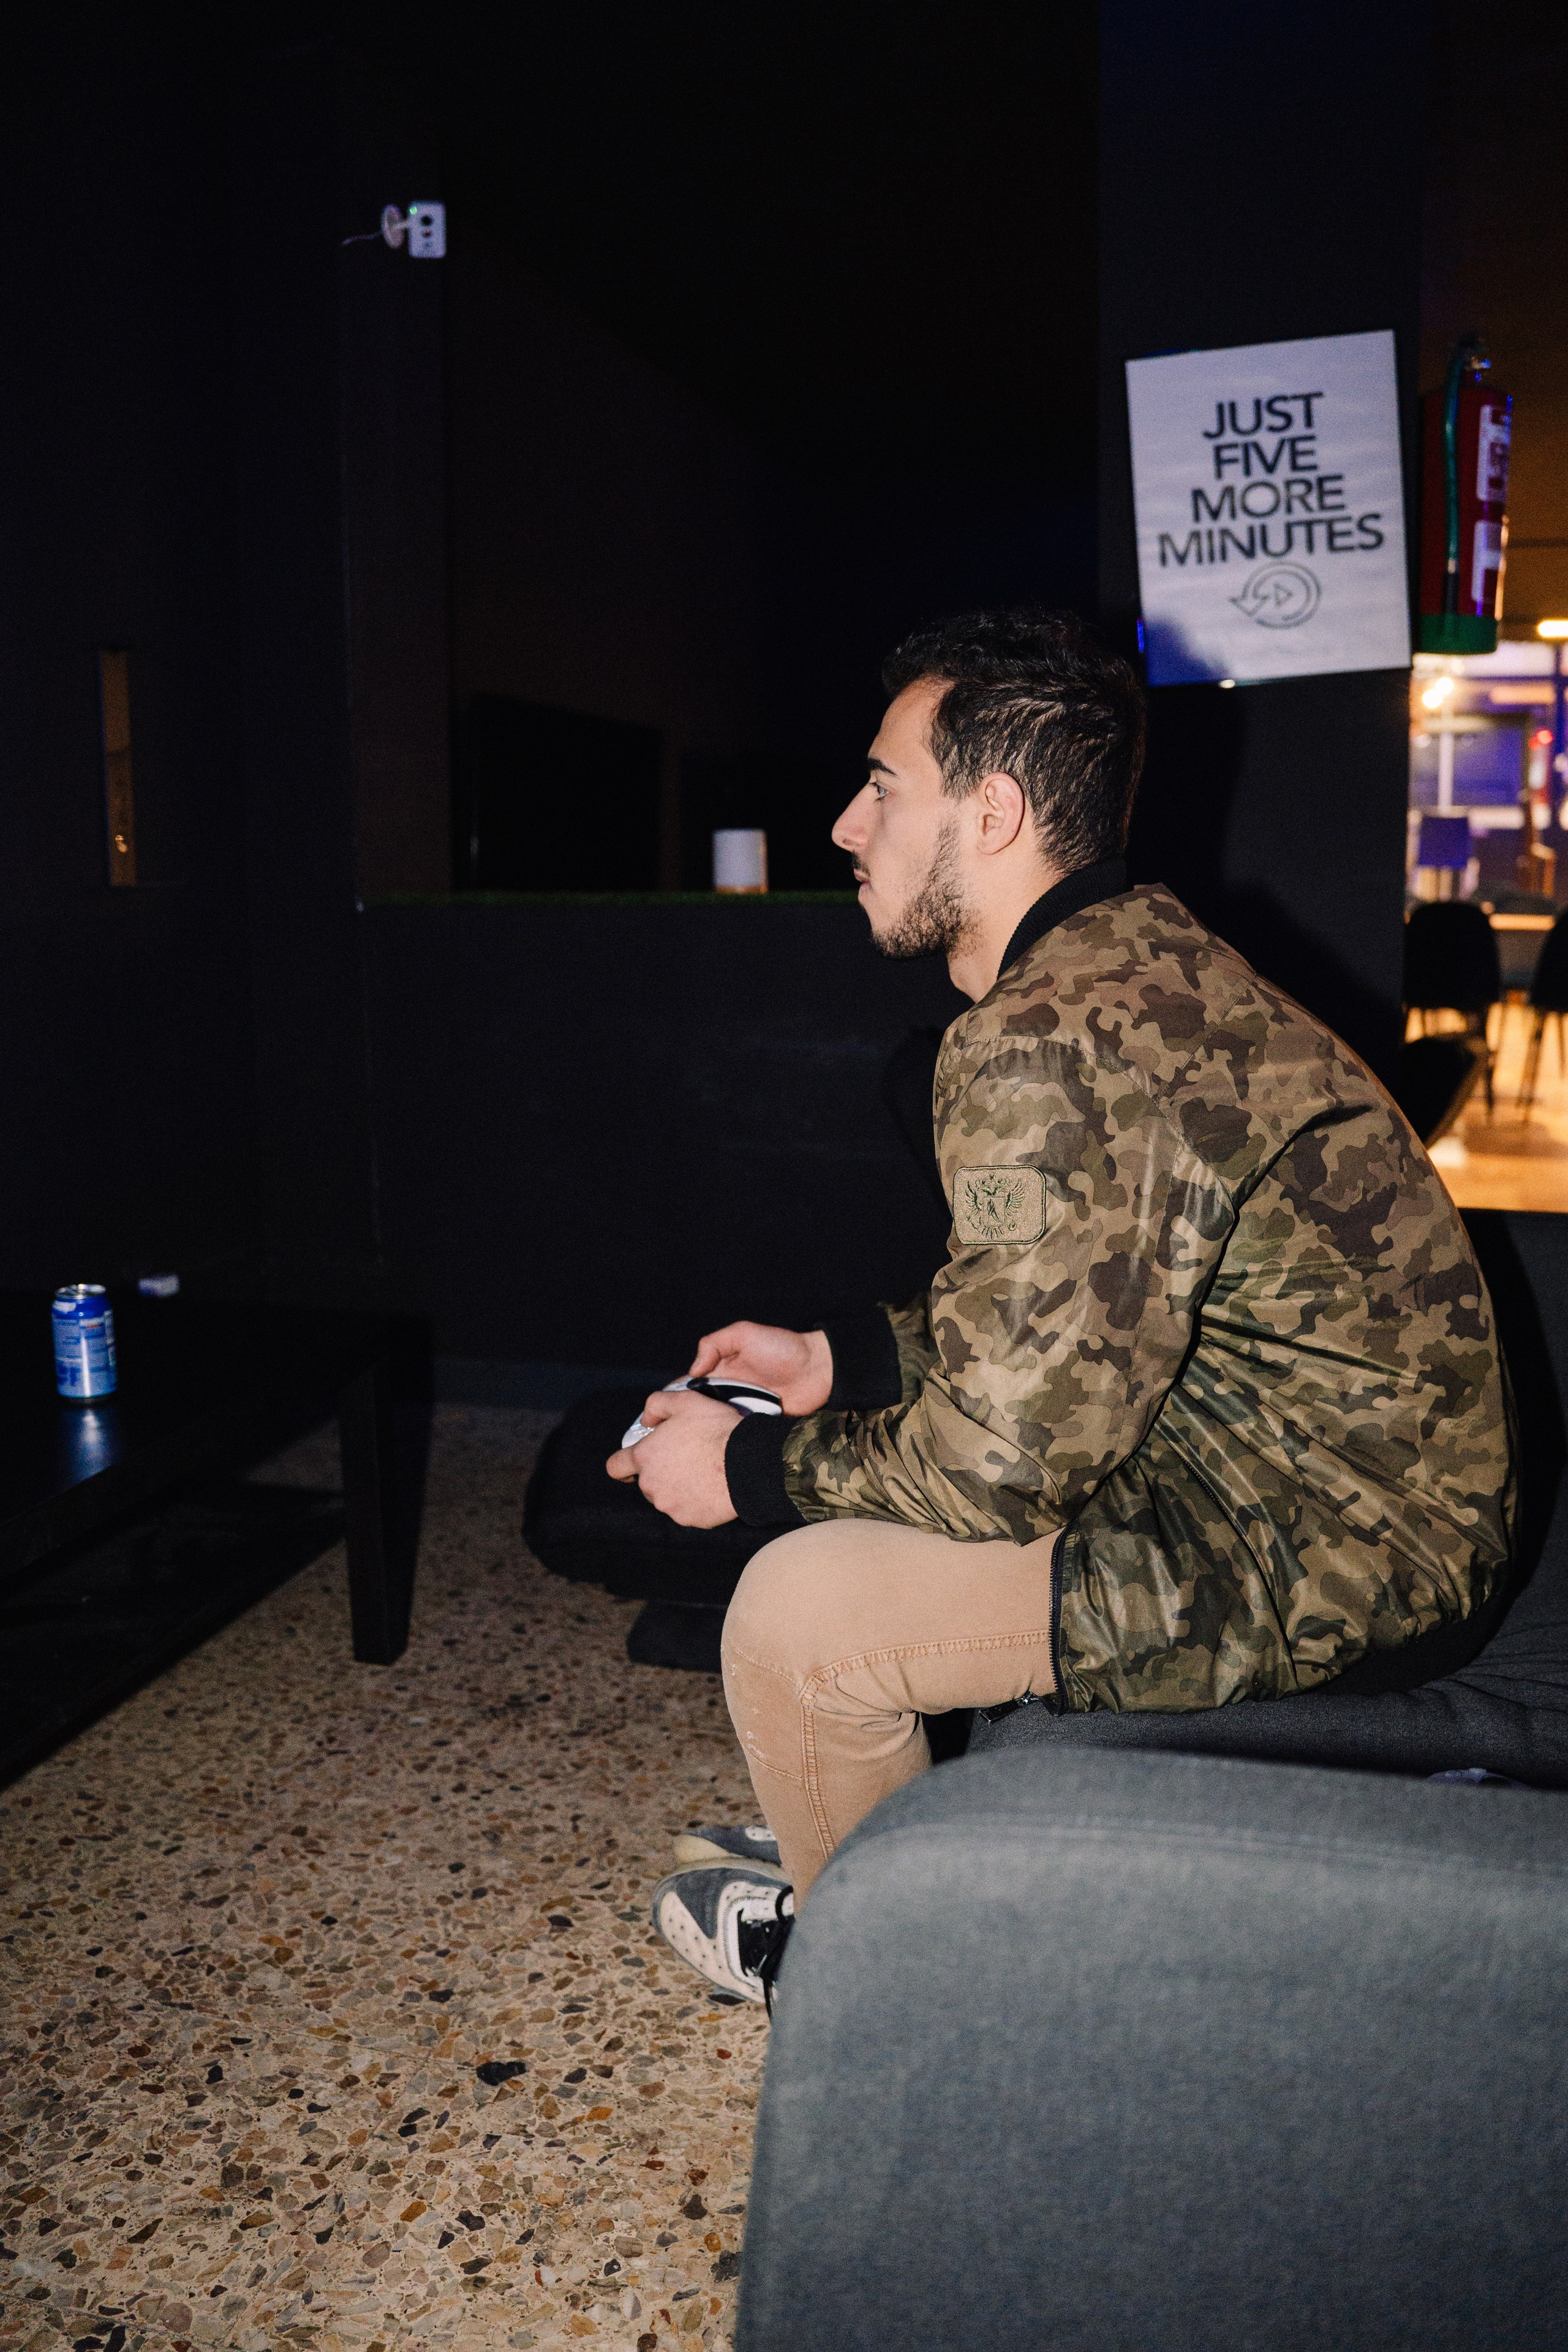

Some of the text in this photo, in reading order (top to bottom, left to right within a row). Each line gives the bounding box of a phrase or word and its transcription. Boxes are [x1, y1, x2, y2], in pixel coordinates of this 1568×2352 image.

[1202, 392, 1324, 439] JUST
[1213, 435, 1318, 479] FIVE
[1191, 475, 1346, 524] MORE
[1157, 513, 1384, 567] MINUTES
